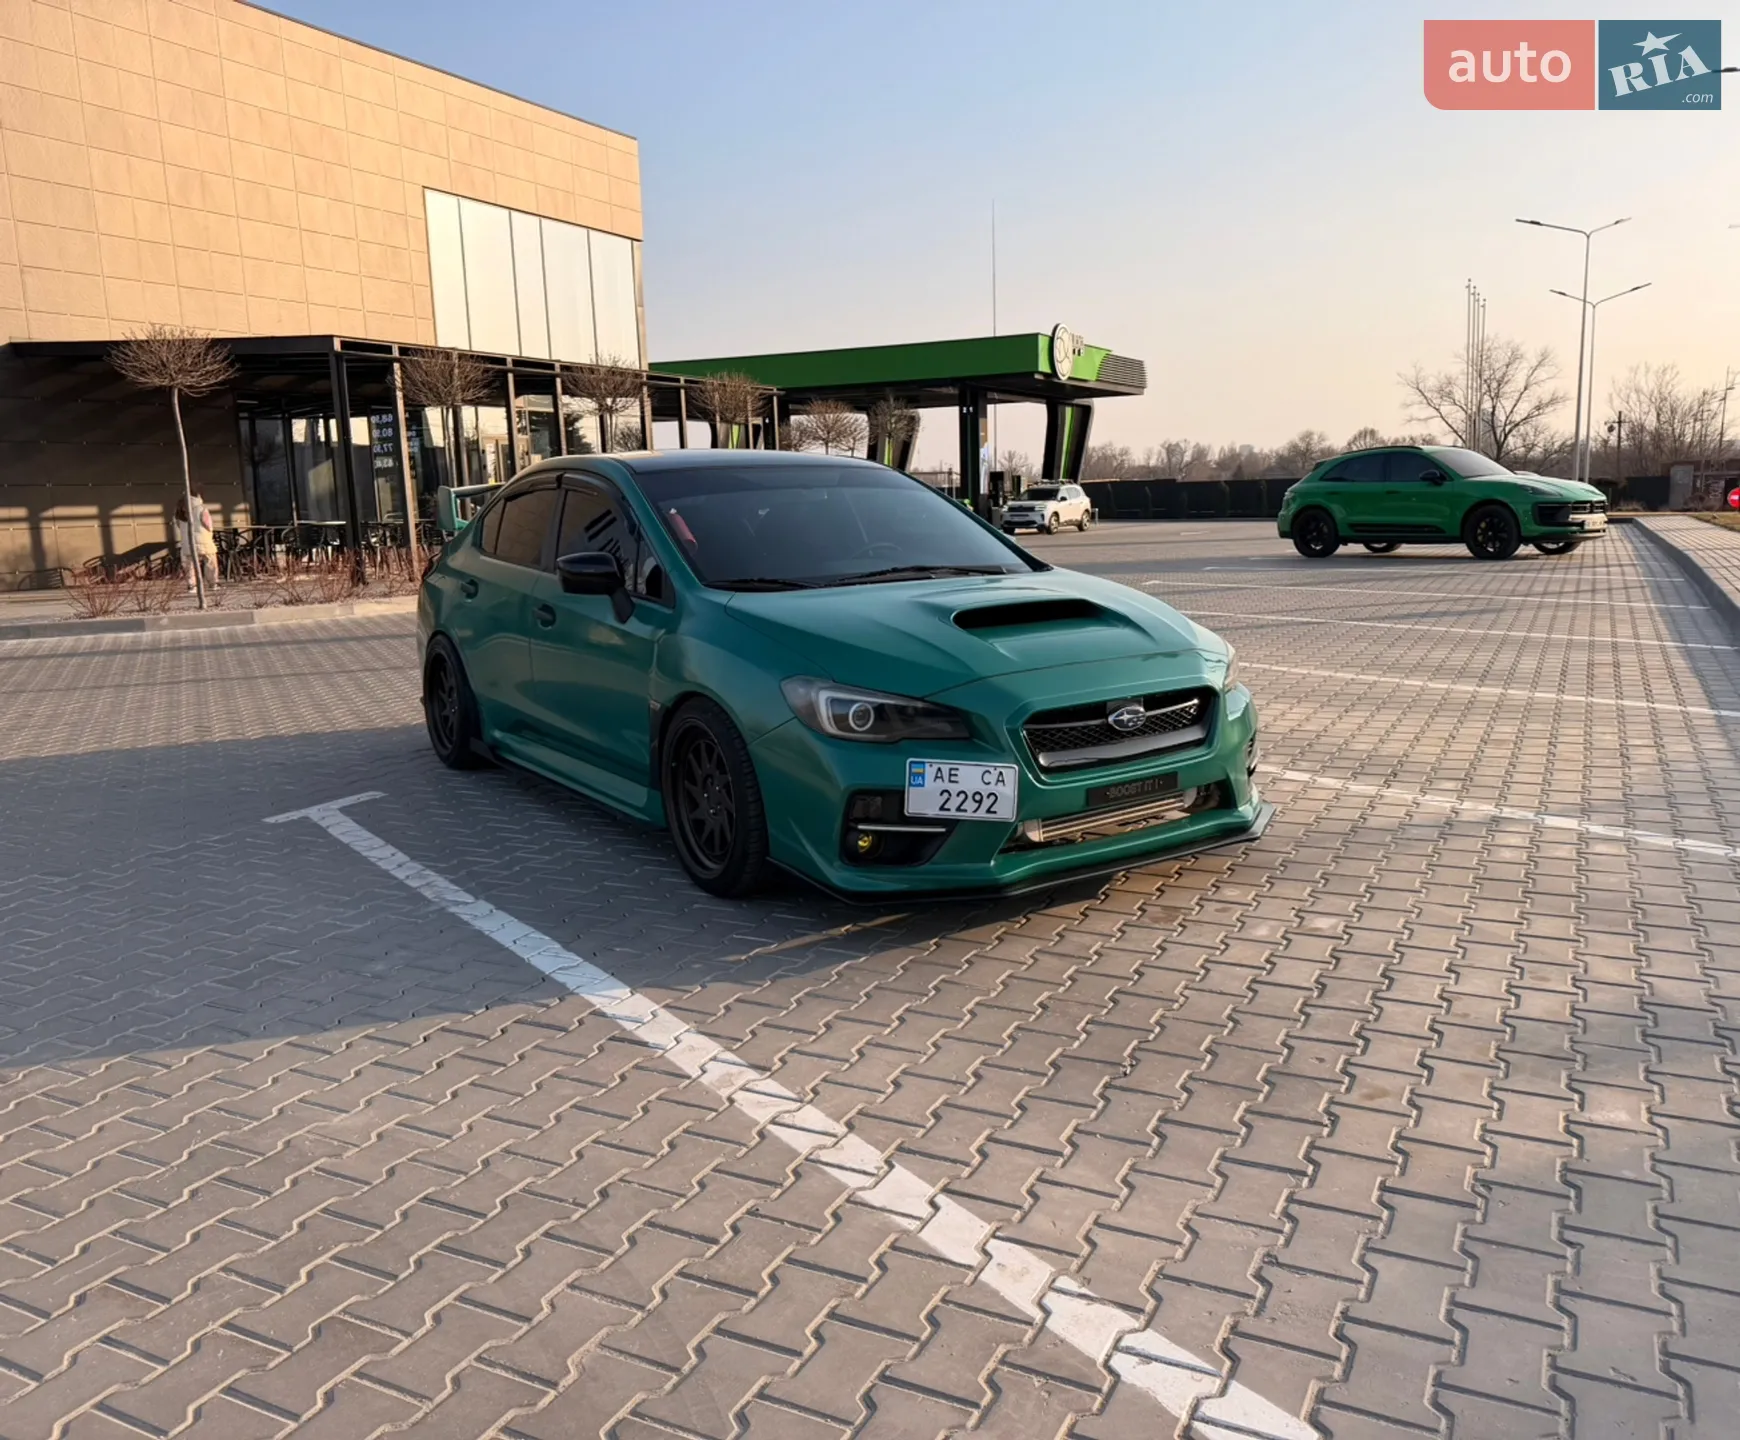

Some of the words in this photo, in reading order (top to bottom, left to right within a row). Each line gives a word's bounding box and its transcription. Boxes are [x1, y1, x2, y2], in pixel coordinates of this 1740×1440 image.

[910, 775, 924, 786] UA
[933, 766, 960, 784] AE
[981, 769, 1006, 787] CA
[938, 789, 999, 815] 2292
